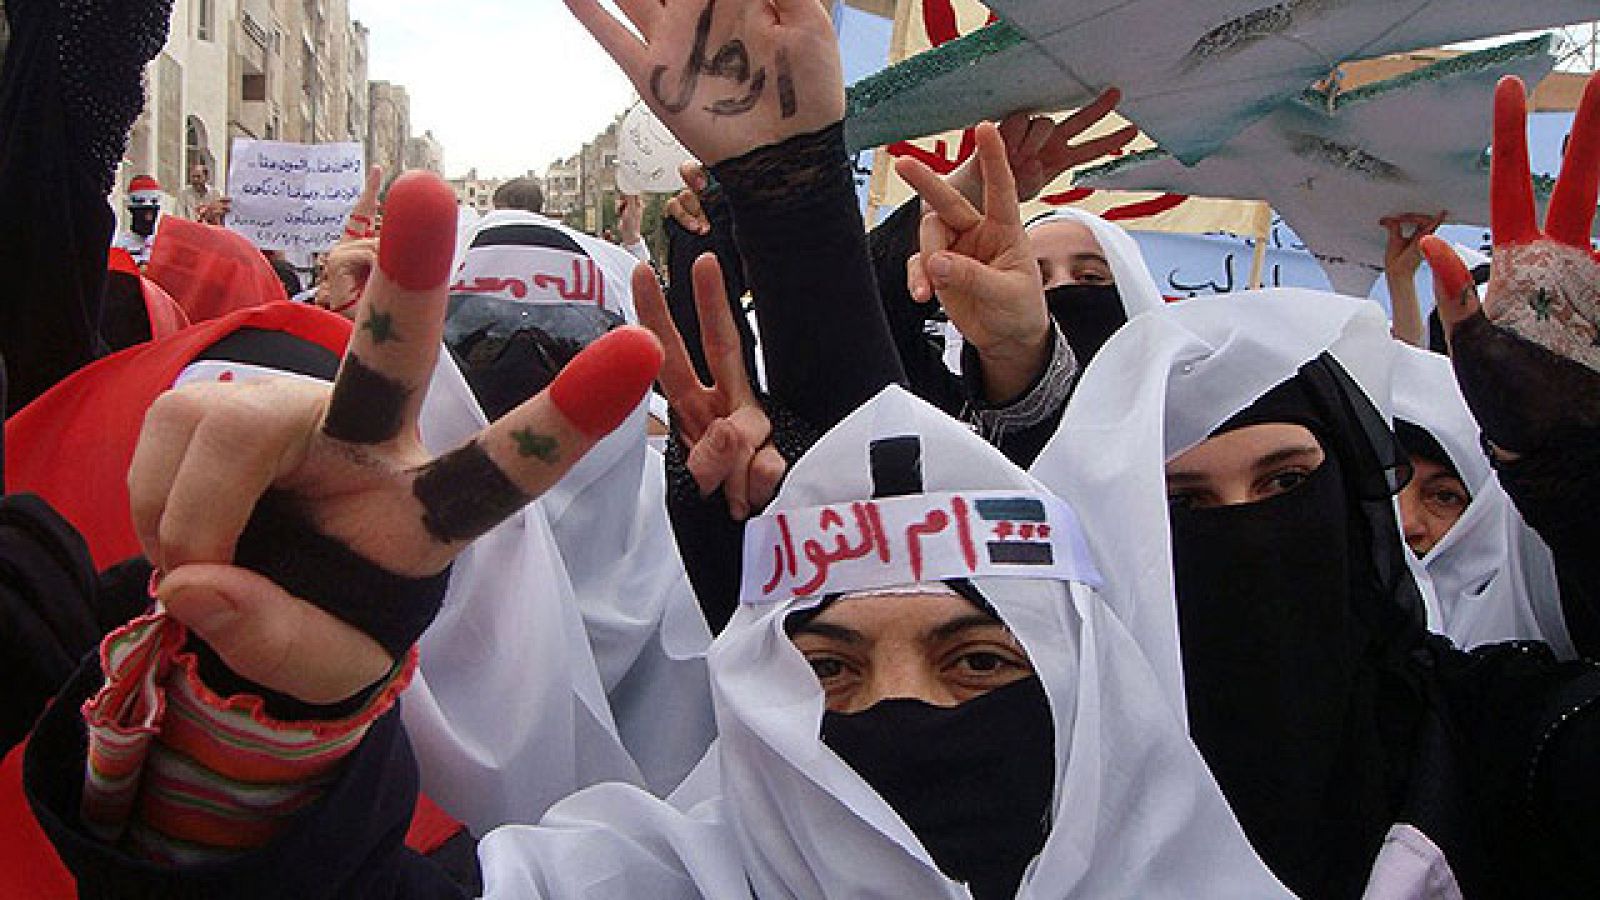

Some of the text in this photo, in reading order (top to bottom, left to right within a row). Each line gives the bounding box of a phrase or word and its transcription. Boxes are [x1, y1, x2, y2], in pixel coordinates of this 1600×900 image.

[650, 0, 798, 118] ارحل
[449, 258, 606, 311] الله معن
[761, 500, 891, 597] الثوار
